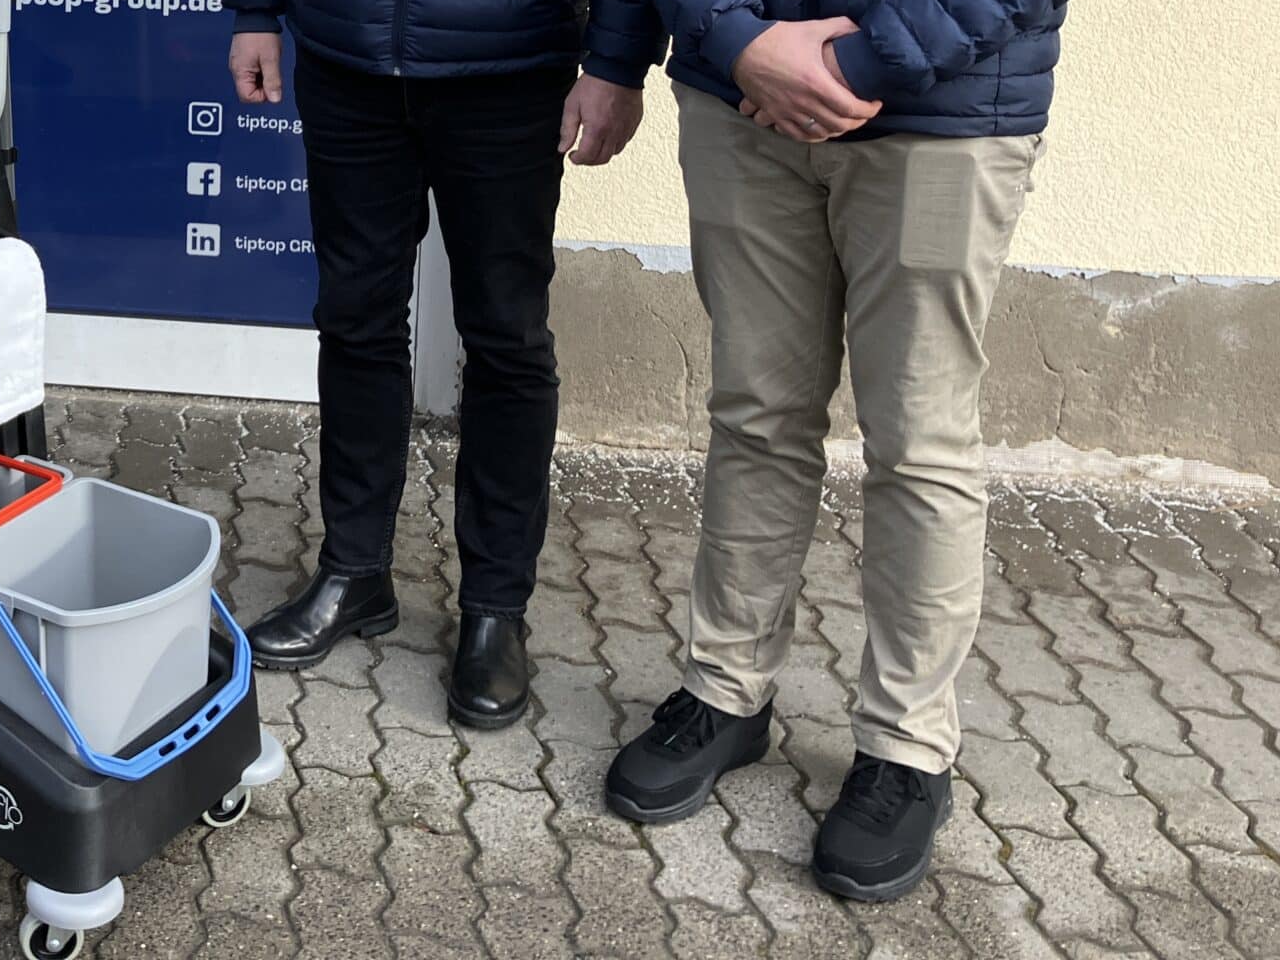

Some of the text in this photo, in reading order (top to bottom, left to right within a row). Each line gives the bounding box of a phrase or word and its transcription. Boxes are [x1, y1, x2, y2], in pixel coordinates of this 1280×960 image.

[236, 114, 303, 134] tiptop.g
[235, 175, 287, 195] tiptop
[290, 178, 309, 192] GR
[235, 236, 286, 255] tiptop
[289, 239, 316, 253] GR
